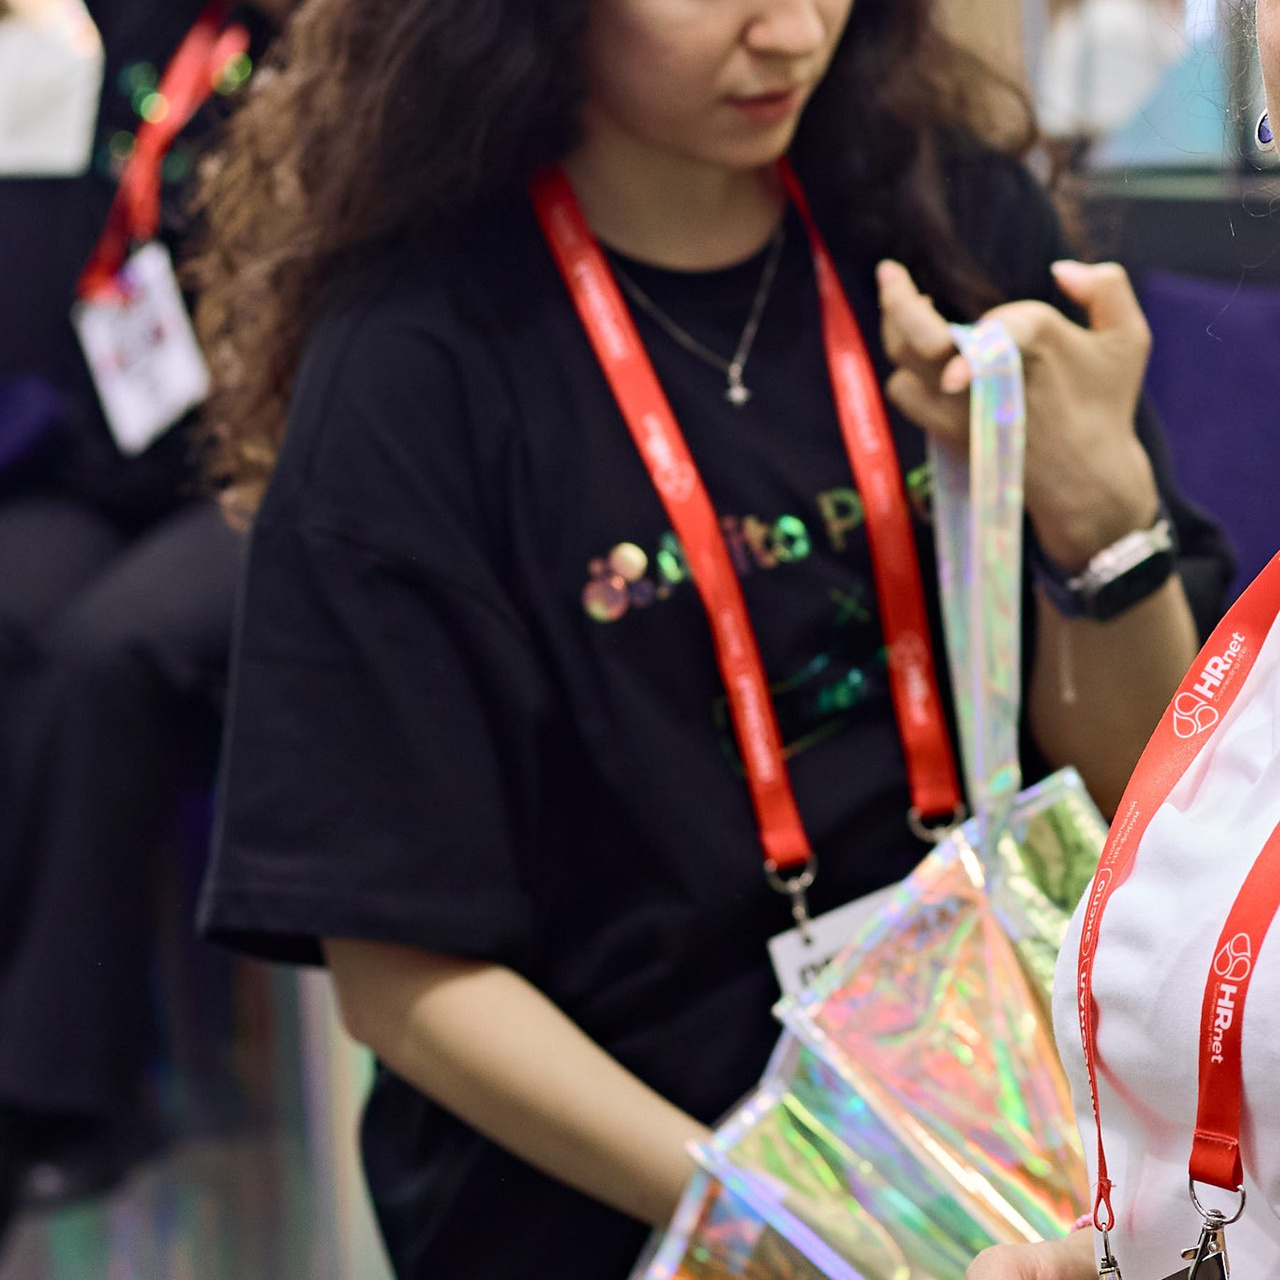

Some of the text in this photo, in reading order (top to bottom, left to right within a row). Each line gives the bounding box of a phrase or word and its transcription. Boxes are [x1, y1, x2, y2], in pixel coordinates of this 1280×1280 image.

[1193, 631, 1246, 700] HRnet
[1084, 880, 1105, 943] ЭКСПО
[1211, 983, 1238, 1064] HRnet
